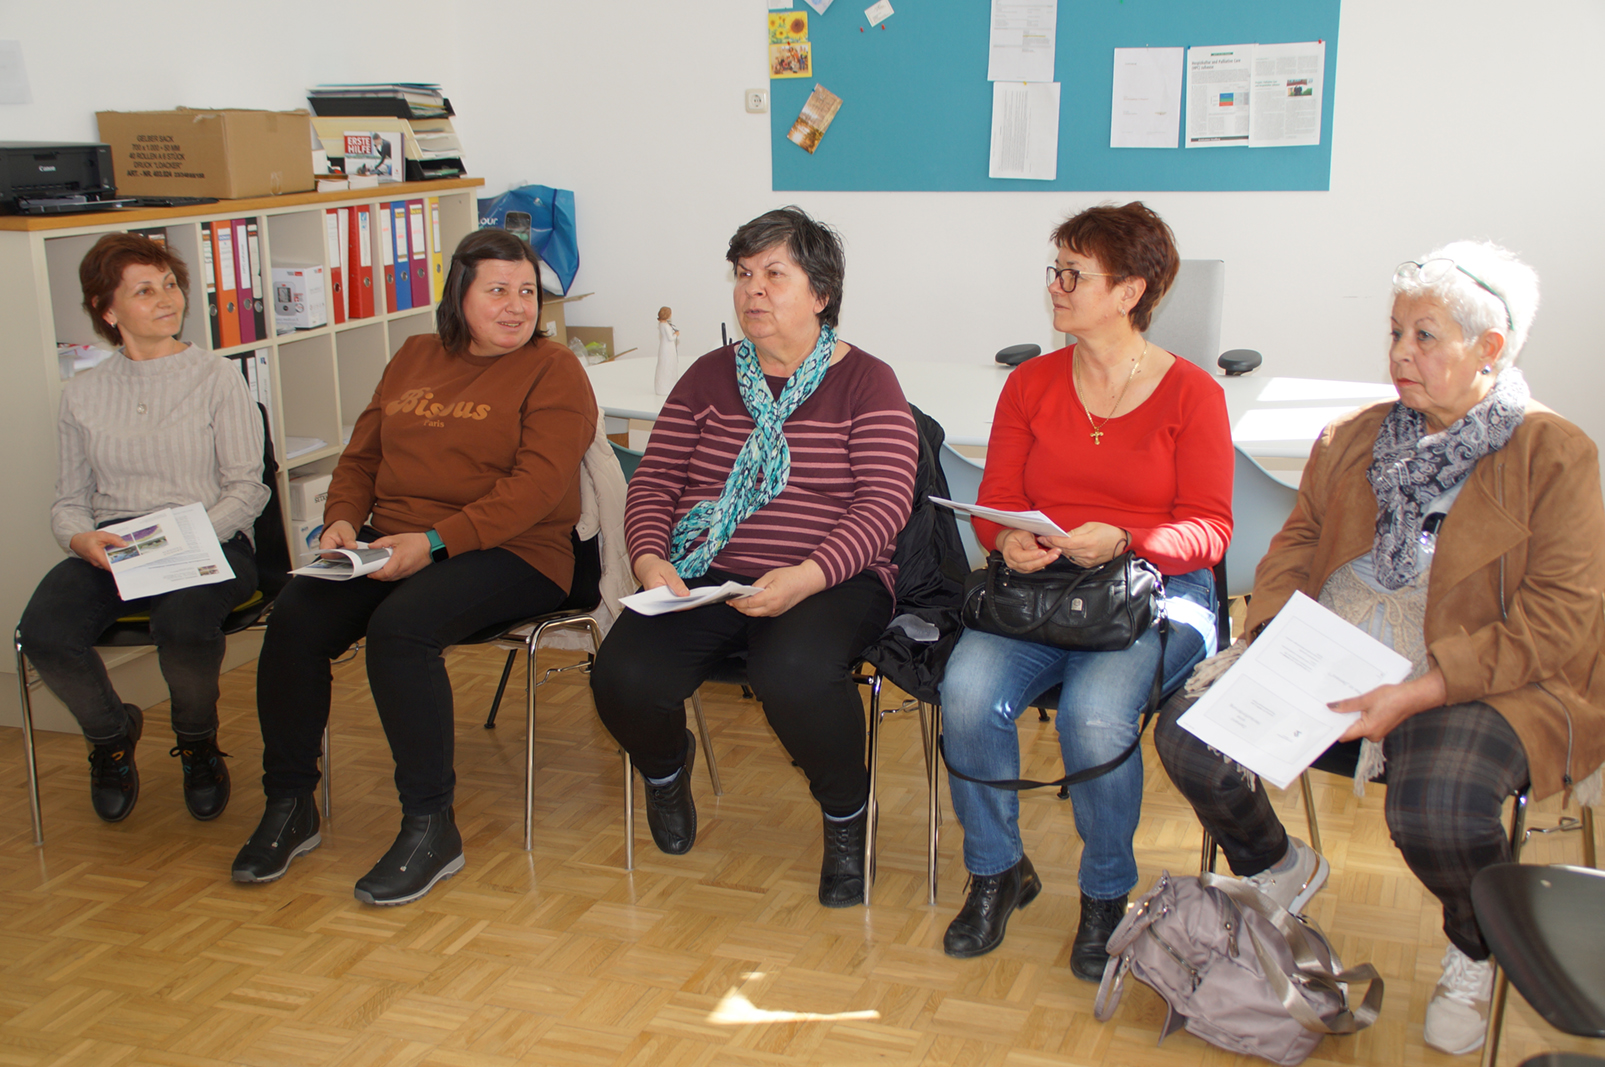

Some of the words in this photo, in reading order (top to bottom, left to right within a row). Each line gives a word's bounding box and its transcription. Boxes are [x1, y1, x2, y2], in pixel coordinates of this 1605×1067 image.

[348, 136, 370, 145] ERSTE
[348, 145, 370, 154] HILFE
[136, 152, 158, 160] ROLLEN
[479, 217, 498, 226] our
[423, 419, 445, 428] Paris
